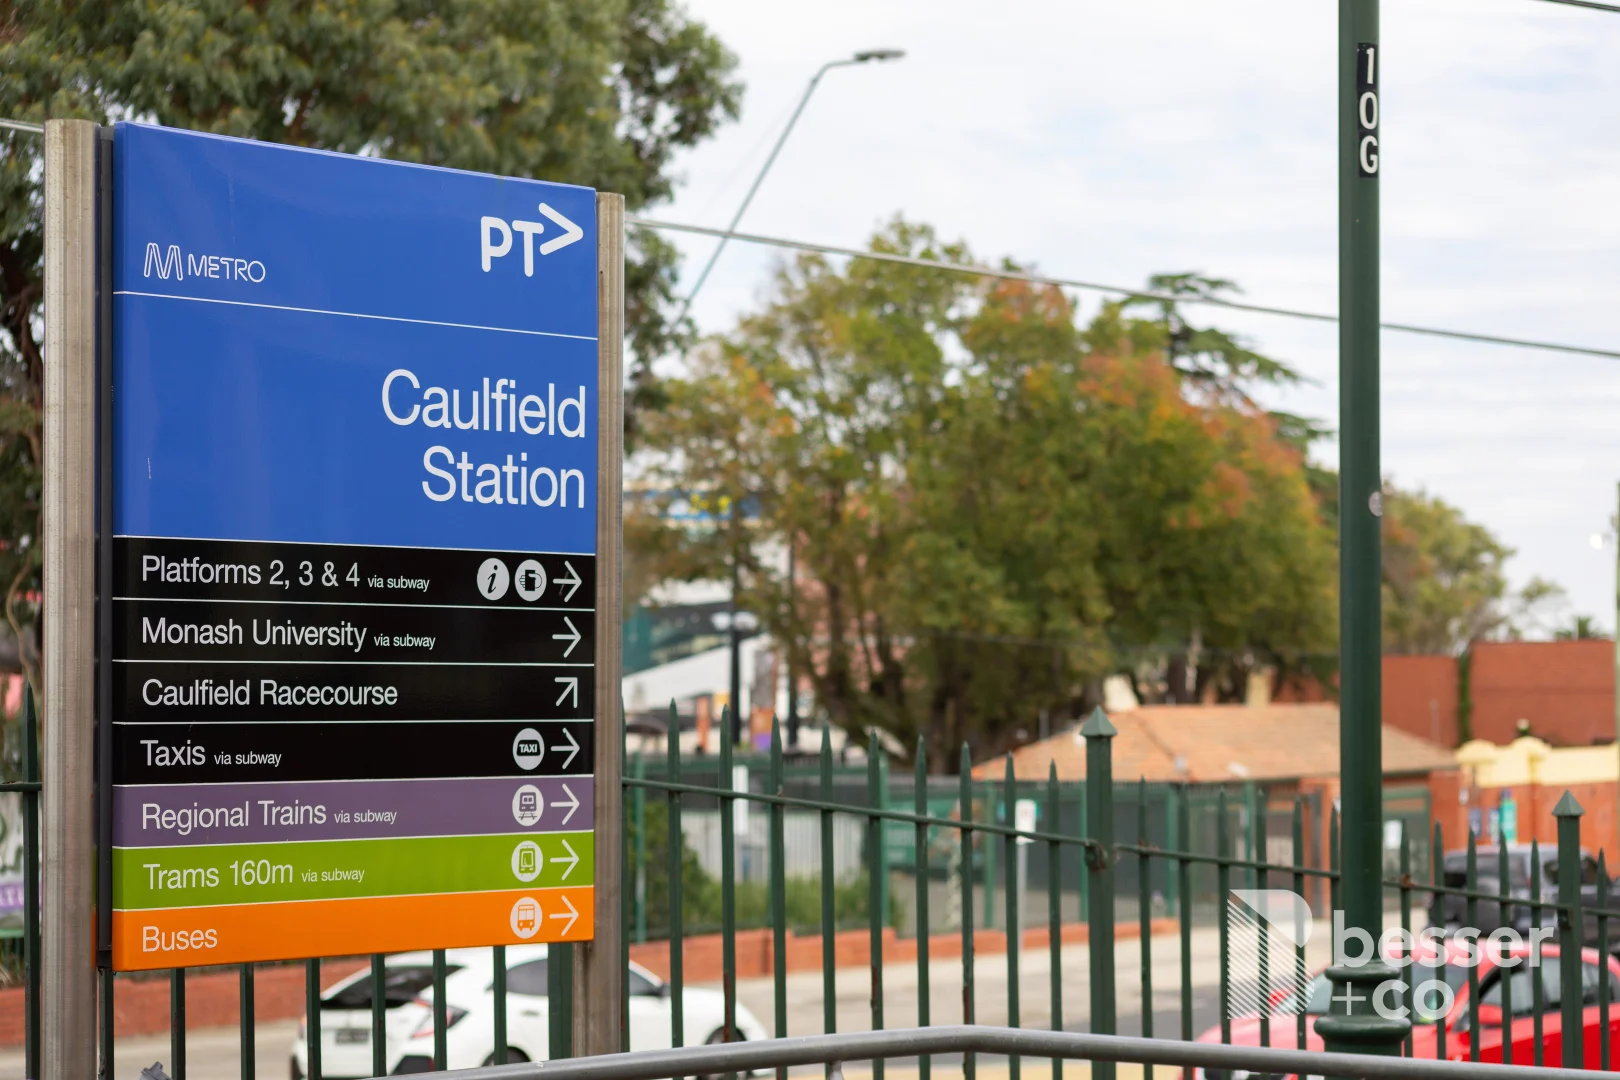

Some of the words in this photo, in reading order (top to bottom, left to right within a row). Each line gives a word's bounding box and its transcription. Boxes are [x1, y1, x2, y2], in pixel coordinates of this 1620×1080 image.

[187, 253, 266, 283] METRO
[381, 368, 586, 438] Caulfield
[421, 445, 585, 509] Station
[142, 554, 262, 585] Platforms
[269, 559, 290, 590] 2,
[298, 560, 314, 587] 3
[321, 561, 339, 587] &
[345, 562, 361, 588] 4
[367, 577, 385, 588] via
[386, 575, 430, 593] subway
[142, 616, 243, 645] Monash
[252, 618, 368, 653] University
[373, 633, 391, 647] via
[392, 633, 436, 651] subway
[142, 678, 250, 706] Caulfield
[260, 679, 398, 706] Racecourse
[140, 739, 206, 767] Taxis
[213, 754, 232, 765] via
[235, 750, 282, 768] subway
[518, 743, 538, 753] TAXI
[142, 800, 249, 836] Regional
[257, 799, 327, 826] Trains
[333, 812, 351, 824] via
[353, 809, 398, 825] subway
[143, 863, 220, 890] Trams
[229, 859, 293, 886] 160m
[301, 868, 318, 883] via
[320, 867, 365, 883] subway
[142, 925, 218, 953] Buses
